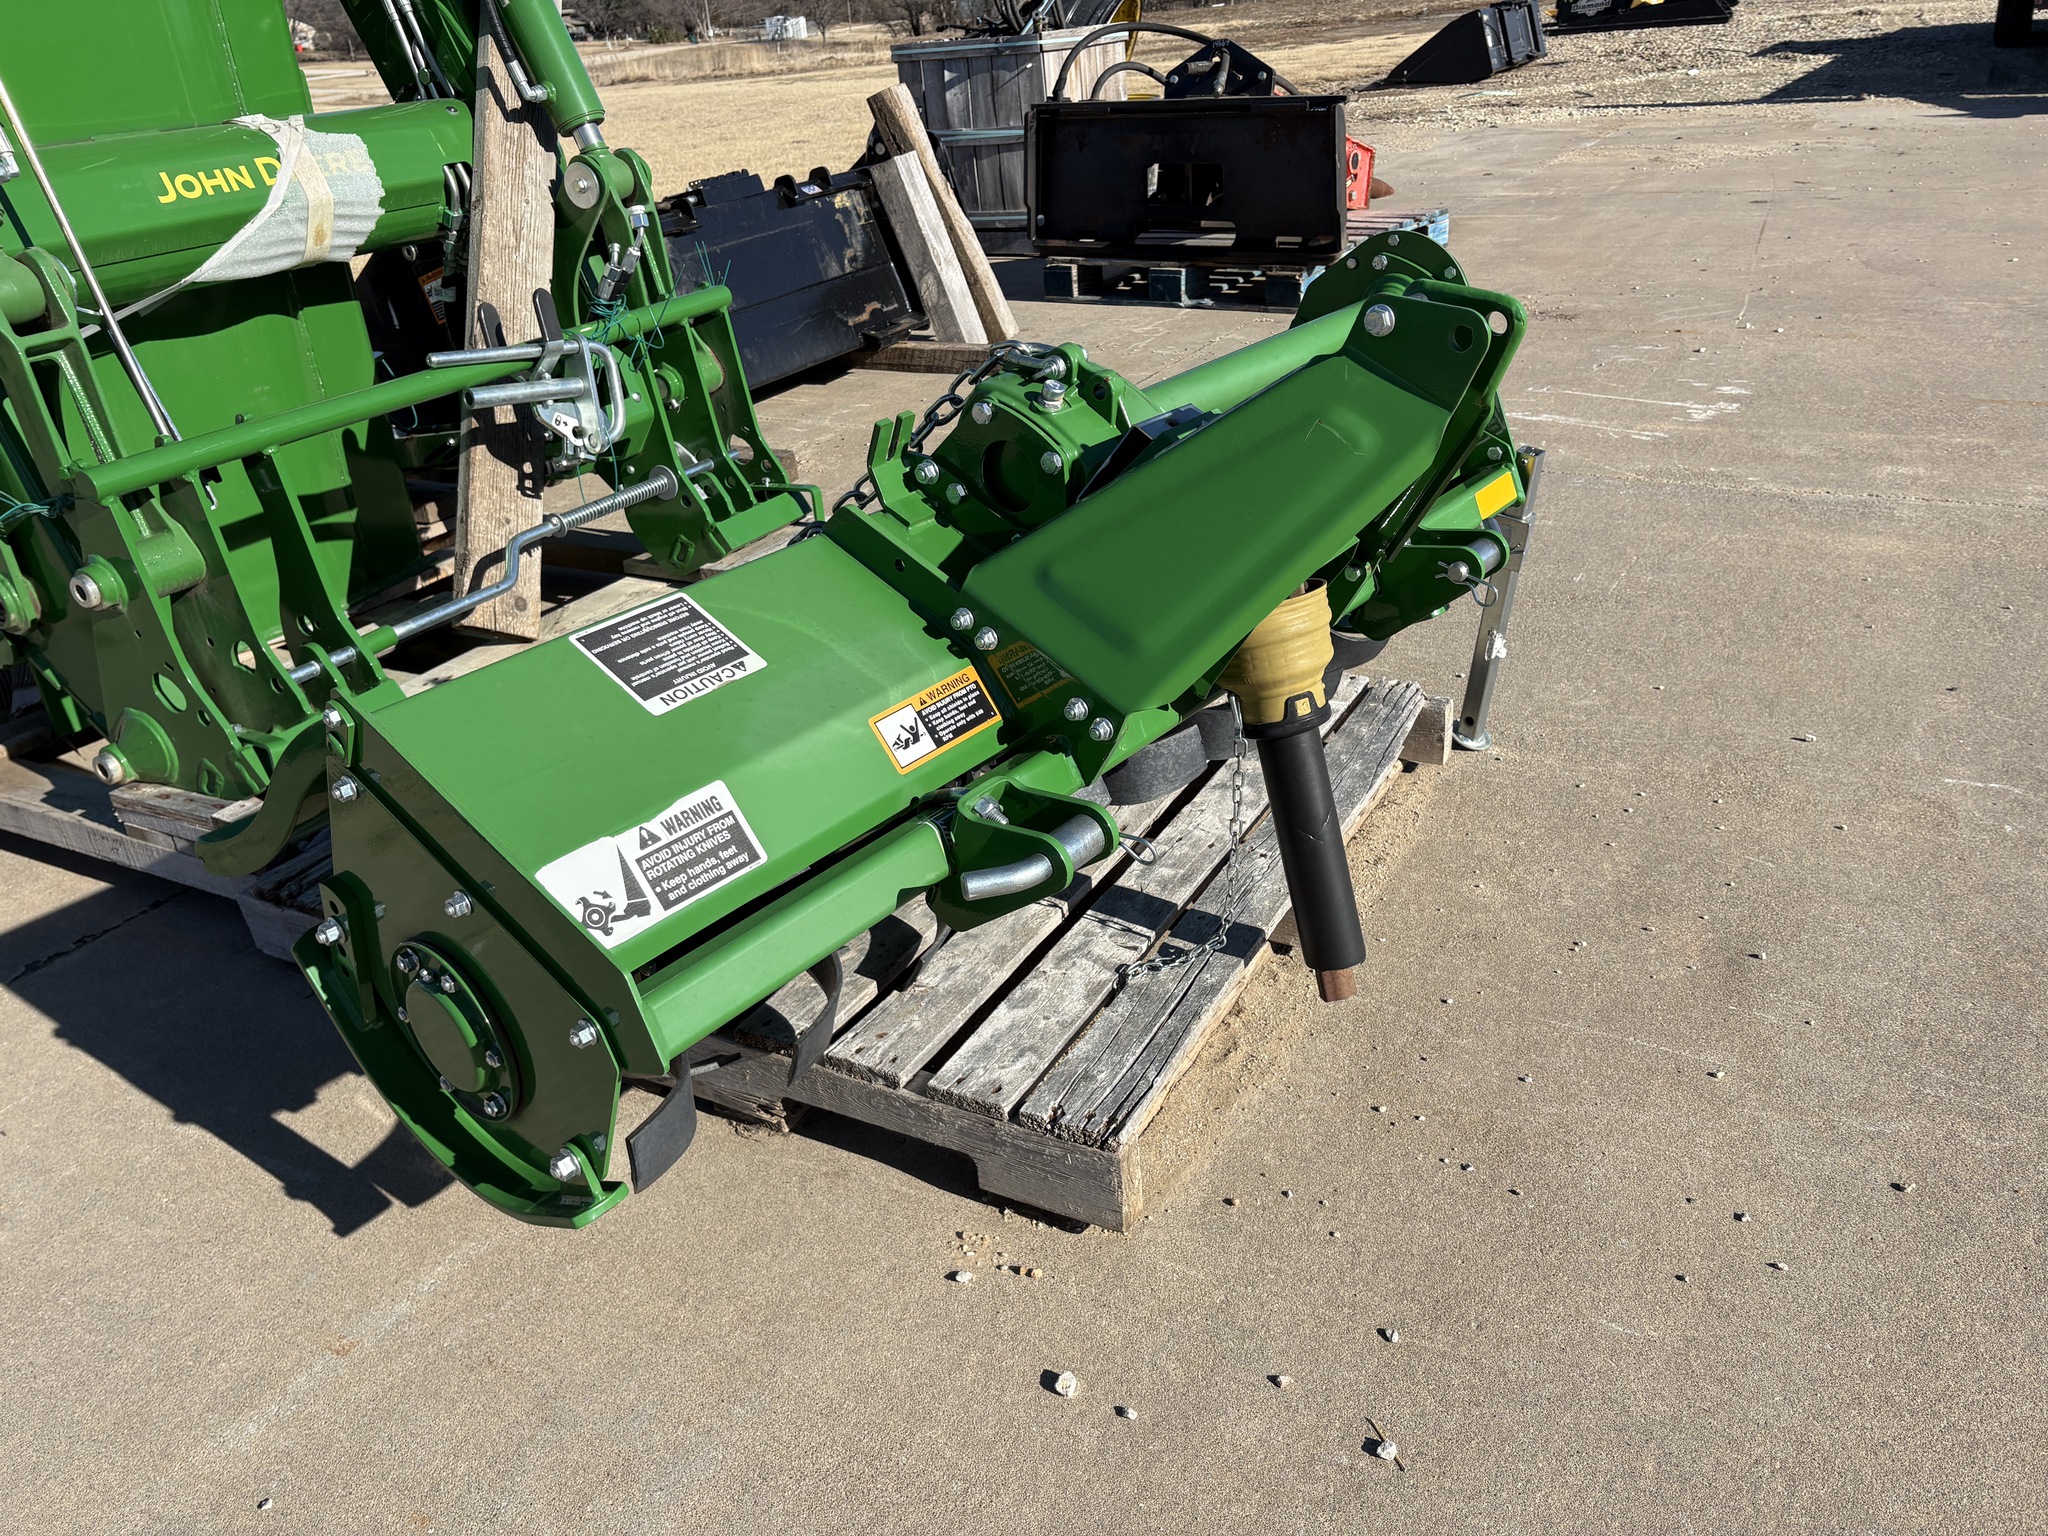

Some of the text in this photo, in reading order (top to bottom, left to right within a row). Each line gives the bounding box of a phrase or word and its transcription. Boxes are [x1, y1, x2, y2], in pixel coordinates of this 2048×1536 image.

[1572, 0, 1610, 10] Diamond
[158, 164, 255, 204] JOHN
[668, 602, 684, 610] Lower
[650, 614, 668, 622] engine
[667, 612, 689, 623] BEFORE
[618, 620, 640, 630] machine
[620, 625, 640, 635] remove
[630, 620, 668, 638] DISMOUNTING
[656, 630, 678, 640] machine
[677, 628, 695, 638] people
[591, 639, 622, 654] SERVICING
[668, 639, 684, 647] riders
[670, 642, 687, 652] power
[682, 643, 701, 652] shields
[712, 642, 730, 651] Ballast
[653, 650, 670, 659] driven
[690, 644, 712, 654] location
[697, 648, 713, 658] power
[617, 652, 640, 663] distance
[639, 656, 654, 665] parts
[662, 652, 677, 661] place
[676, 646, 735, 673] Read operator's manual
[658, 657, 681, 668] function
[630, 669, 653, 680] controls
[650, 664, 677, 678] operator's
[672, 662, 716, 684] AVOID INJURY
[631, 676, 651, 687] manual
[659, 668, 735, 706] CAUTION
[926, 673, 970, 700] WARNING
[921, 683, 976, 716] AVOID INJURY FROM PTO
[928, 711, 941, 720] Keep
[947, 700, 963, 710] shields
[967, 690, 979, 700] place
[932, 717, 944, 725] Keep
[943, 709, 959, 719] hands,
[936, 712, 965, 731] clothing away
[938, 724, 956, 736] Operate
[942, 732, 953, 741] RPM
[660, 795, 723, 836] WARNING
[641, 815, 735, 870] AVOID INJURY FROM
[645, 830, 731, 880] ROTATING KNIVES
[661, 844, 738, 890] Keep hands, feet
[668, 884, 687, 900] and
[687, 865, 726, 890] clothing
[725, 852, 749, 869] away
